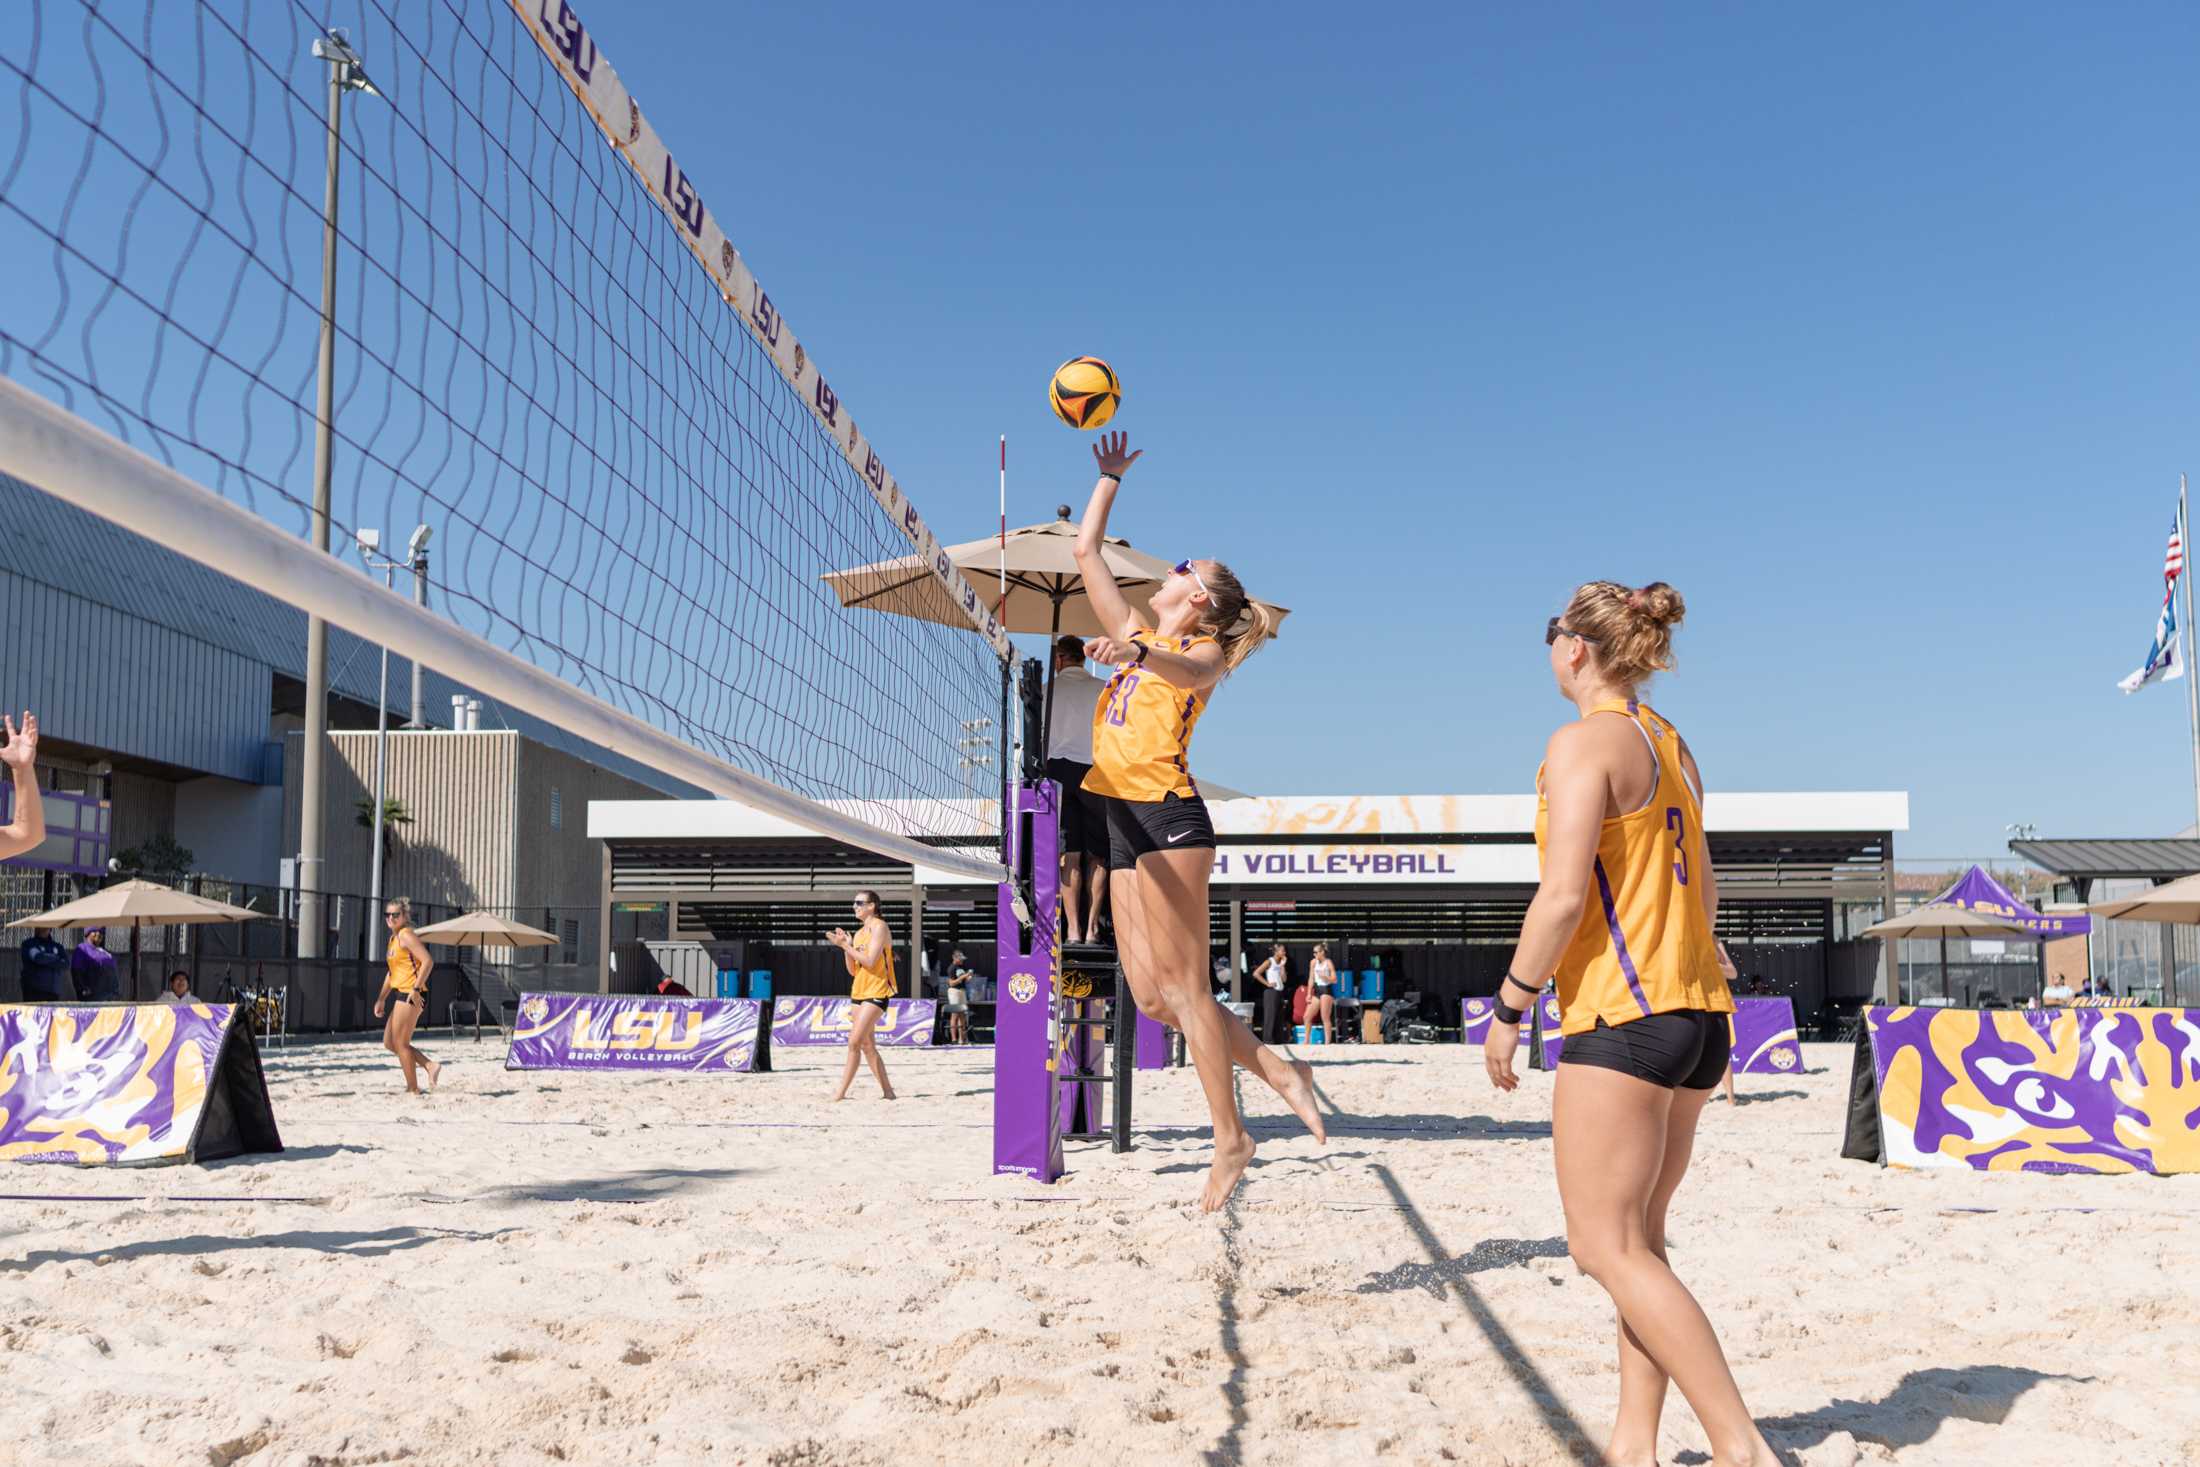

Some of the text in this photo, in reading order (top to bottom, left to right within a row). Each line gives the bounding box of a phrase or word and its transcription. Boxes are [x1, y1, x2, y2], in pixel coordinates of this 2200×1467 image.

[540, 0, 595, 86] LSU
[664, 152, 704, 238] LSU
[751, 278, 781, 348] LSU
[865, 446, 885, 491] LSU
[1244, 854, 1456, 874] VOLLEYBALL
[1666, 807, 1689, 886] 3
[568, 1052, 696, 1062] BEACH VOLLEYBALL
[570, 1010, 703, 1051] LSU
